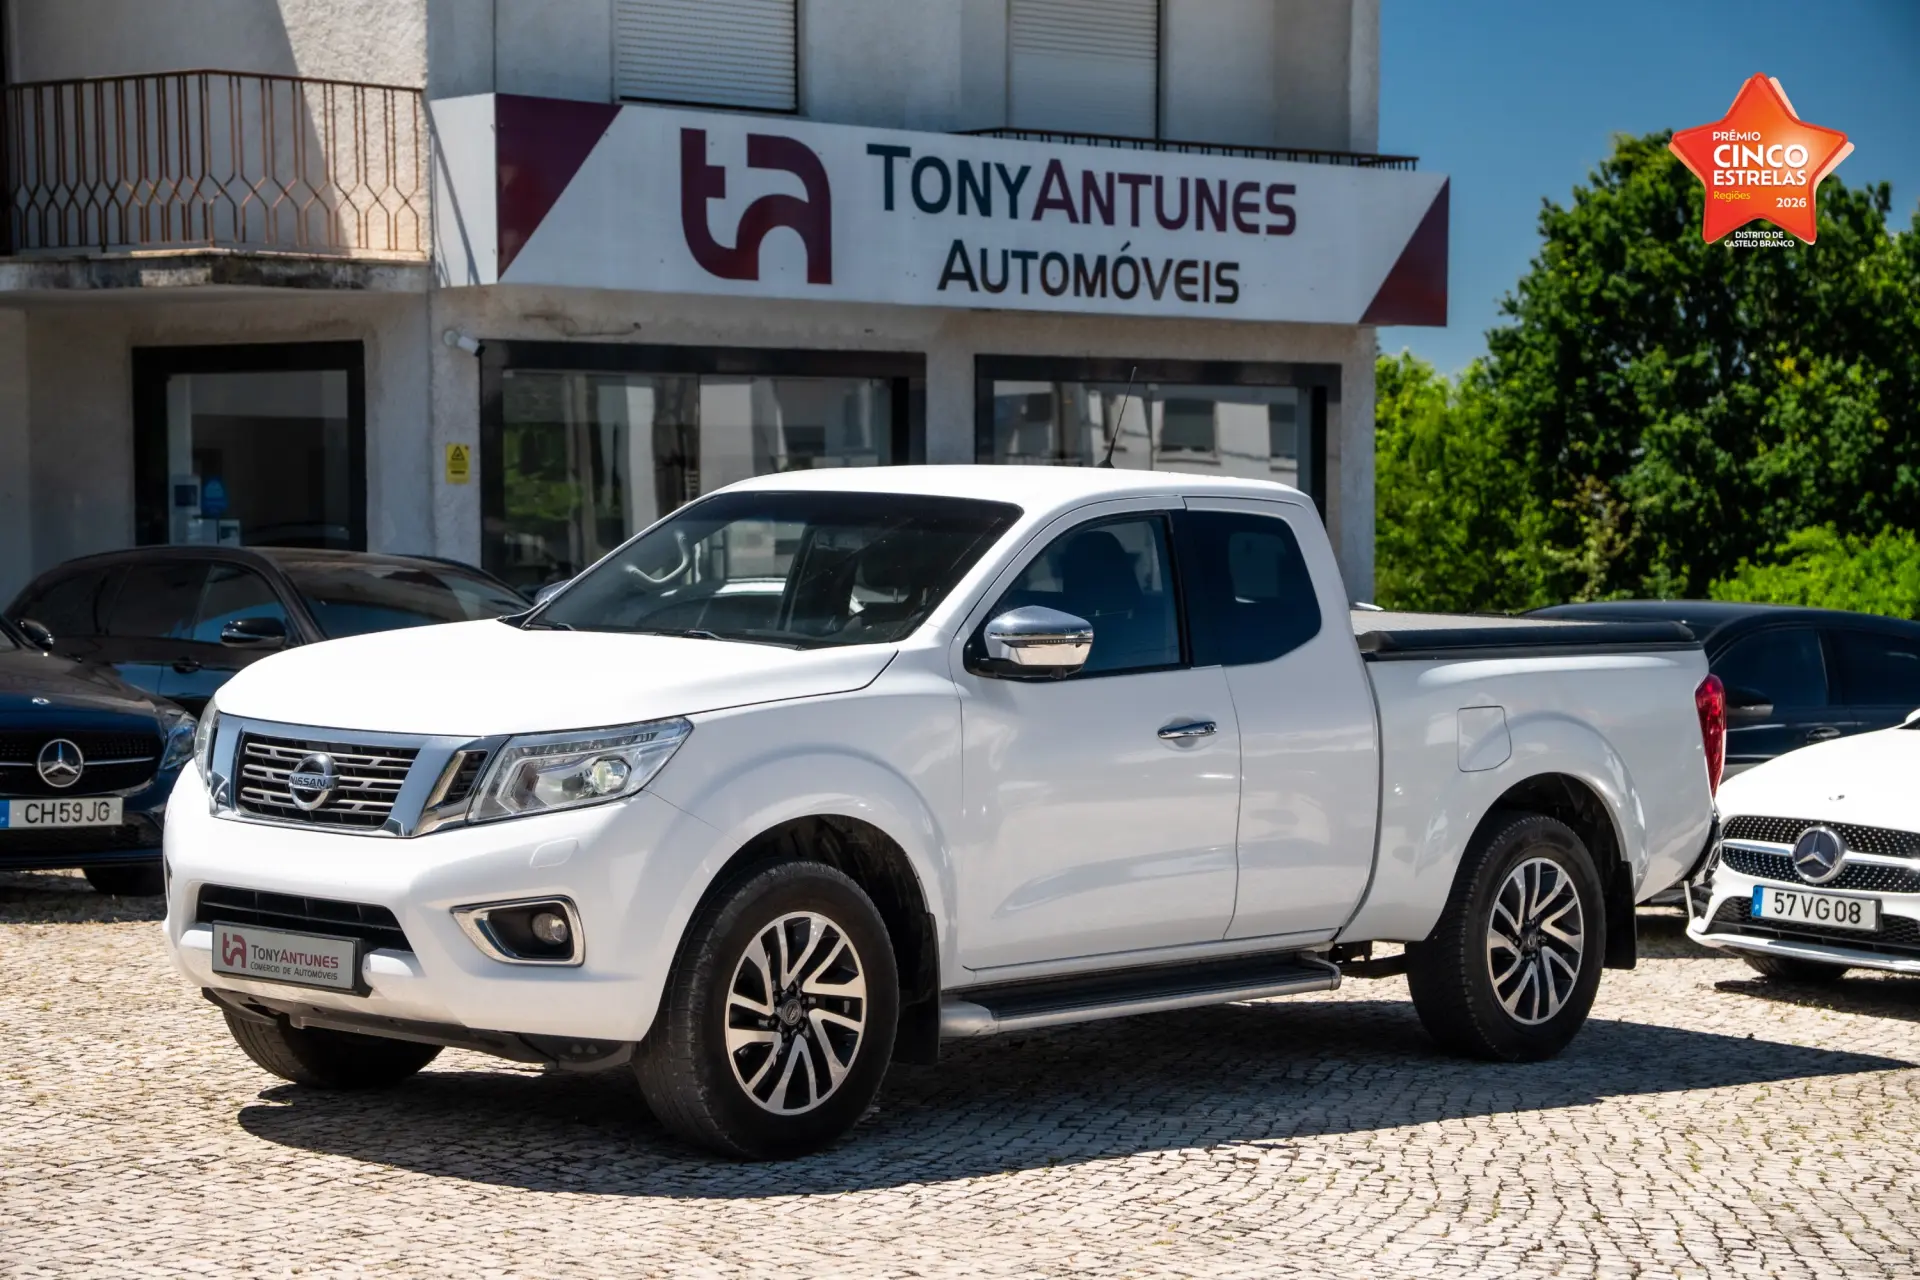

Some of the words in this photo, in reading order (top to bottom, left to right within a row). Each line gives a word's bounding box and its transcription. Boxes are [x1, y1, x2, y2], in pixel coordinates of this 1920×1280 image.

[936, 238, 1241, 304] AUTOMÓVEIS
[290, 776, 326, 788] NISSAN
[282, 966, 292, 976] DE
